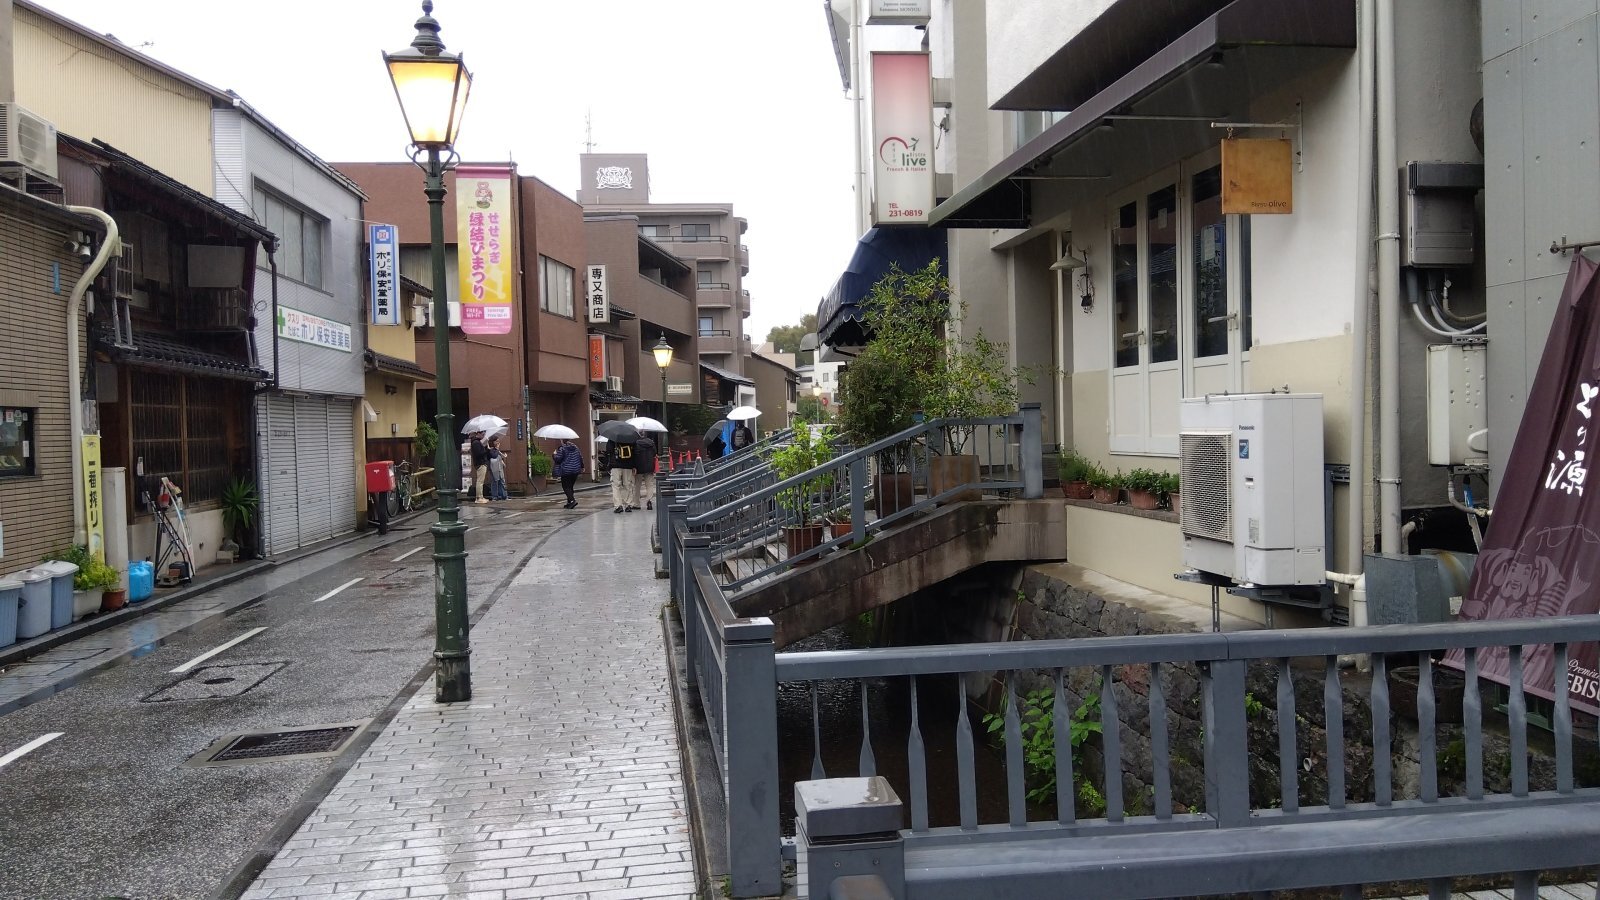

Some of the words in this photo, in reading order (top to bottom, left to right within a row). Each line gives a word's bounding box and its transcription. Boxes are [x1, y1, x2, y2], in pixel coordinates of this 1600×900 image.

[469, 211, 486, 300] 縁結びまつり
[488, 212, 500, 264] せせらぎ
[376, 251, 388, 316] ホリ保安堂薬局
[592, 267, 604, 319] 専又商店
[287, 312, 299, 325] クスリ
[301, 323, 350, 349] ホリ保安堂薬局
[88, 460, 99, 529] 一番搾り
